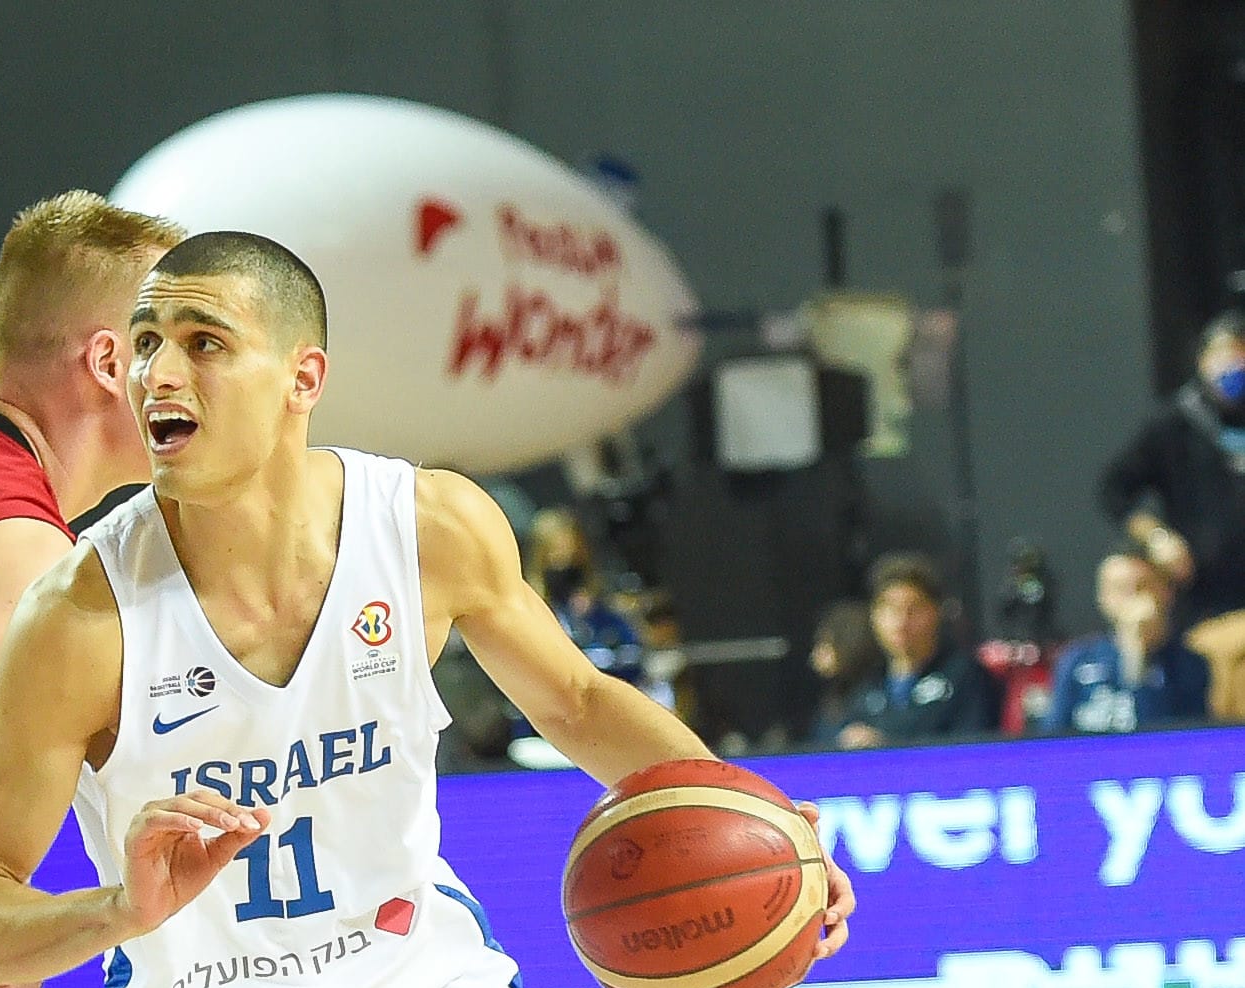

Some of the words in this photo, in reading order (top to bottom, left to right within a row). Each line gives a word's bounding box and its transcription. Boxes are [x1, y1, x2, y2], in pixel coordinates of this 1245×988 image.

[171, 720, 392, 808] ISRAEL
[232, 816, 335, 923] 11
[310, 930, 372, 975] בנק
[621, 905, 736, 954] molten
